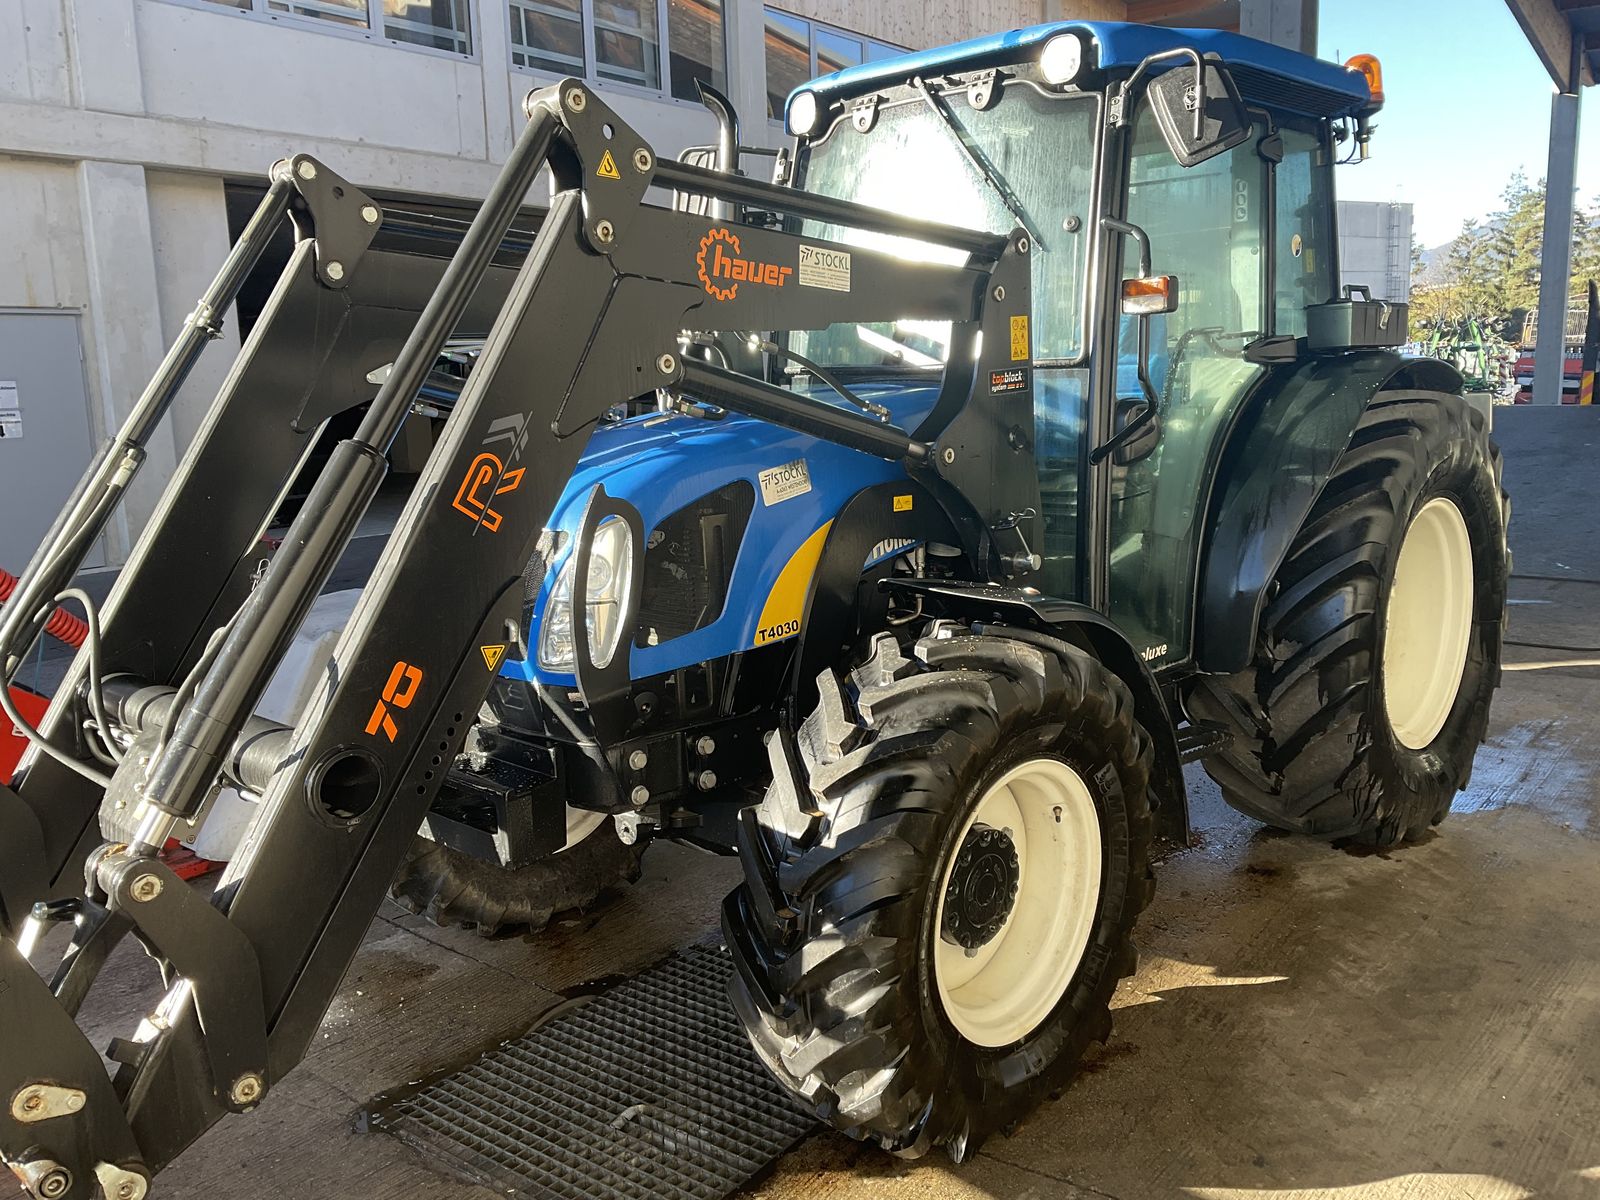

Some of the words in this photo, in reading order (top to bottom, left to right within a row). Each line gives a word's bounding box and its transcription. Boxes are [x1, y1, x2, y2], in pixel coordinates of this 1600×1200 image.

[713, 245, 793, 287] hauer
[758, 619, 799, 641] T4030
[364, 660, 423, 743] 70
